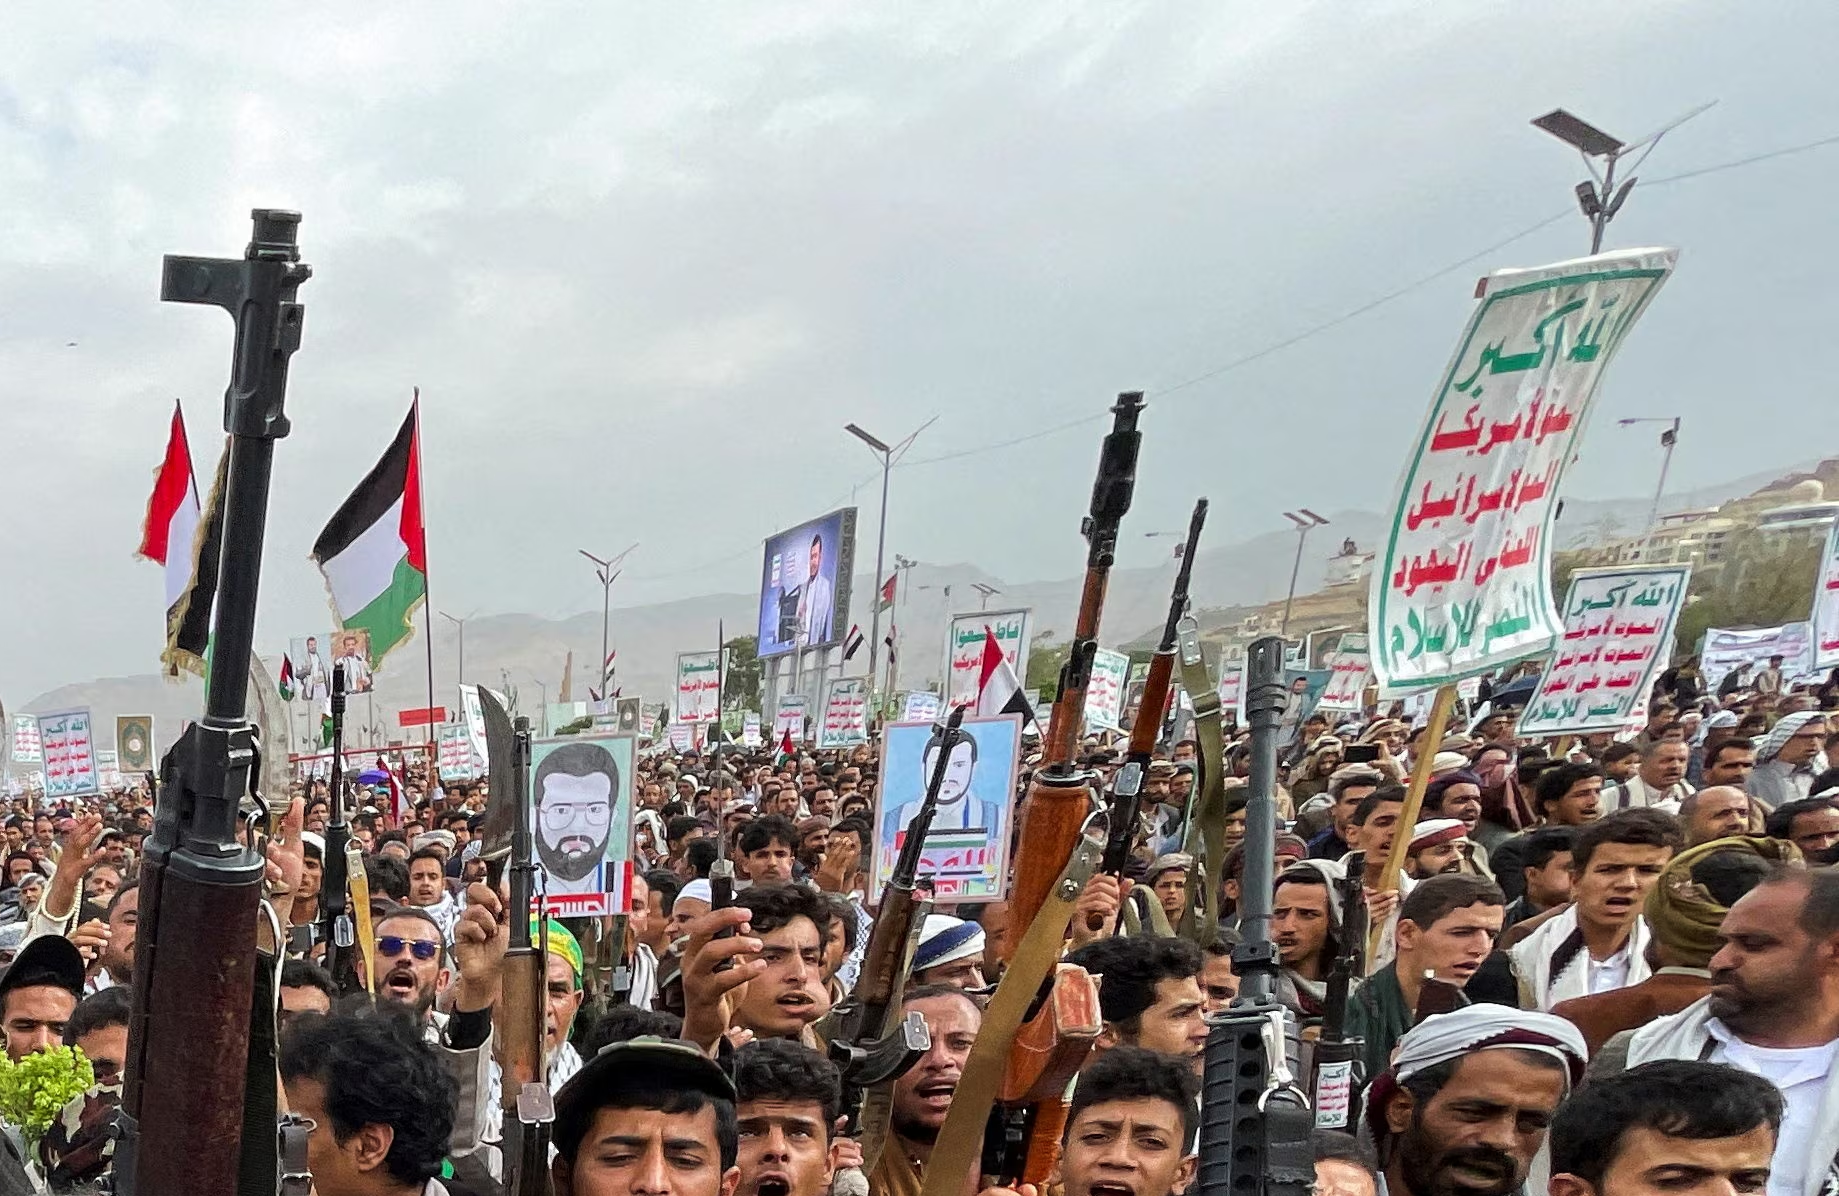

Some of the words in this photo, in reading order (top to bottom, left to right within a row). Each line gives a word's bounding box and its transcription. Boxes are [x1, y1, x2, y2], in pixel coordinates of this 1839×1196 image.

[1453, 290, 1589, 399] أكبر
[1430, 385, 1545, 456] لأمريكا
[1407, 465, 1524, 531] لإسرائيل
[1513, 459, 1560, 514] المو
[1393, 540, 1473, 597] اليهود
[1632, 579, 1676, 607] الله
[1572, 578, 1638, 619] أكبر
[1391, 599, 1481, 673] للإسلام
[1604, 645, 1654, 665] الموت
[1614, 617, 1665, 638] الموت
[1580, 693, 1631, 723] النصر
